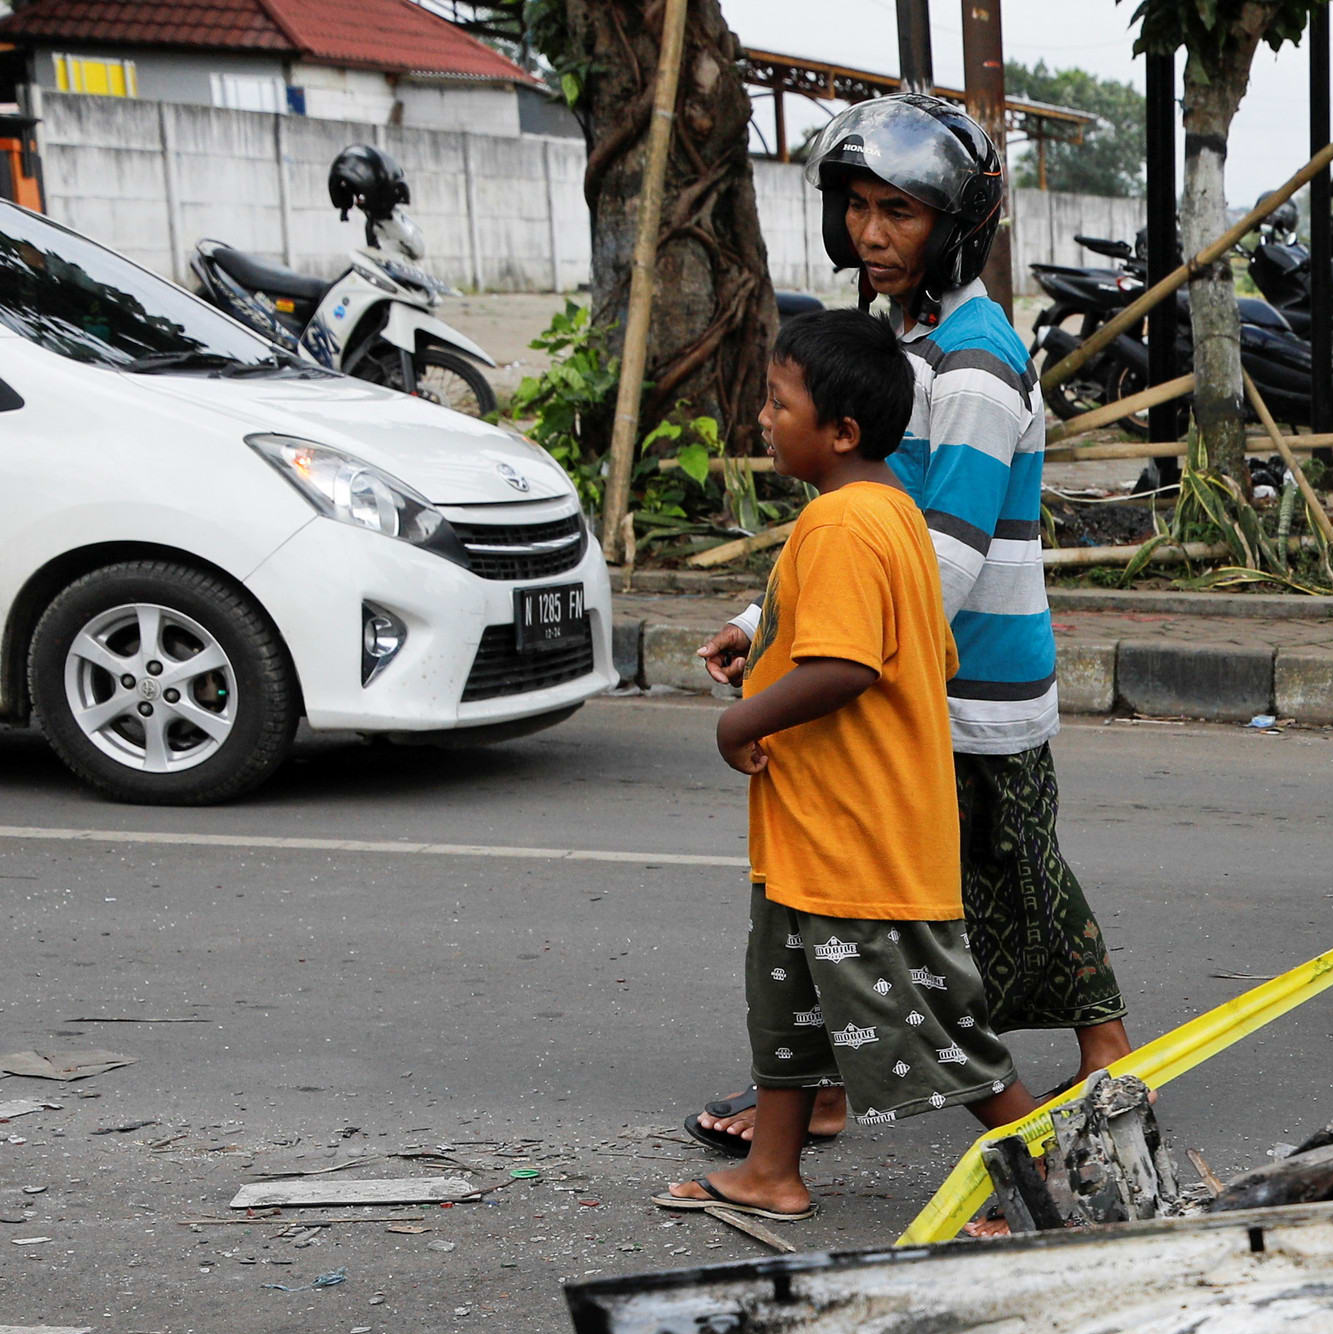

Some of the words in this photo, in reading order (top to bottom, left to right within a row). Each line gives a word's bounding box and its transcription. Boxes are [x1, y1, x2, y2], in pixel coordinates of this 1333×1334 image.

[842, 143, 881, 157] HONDA
[525, 596, 533, 626] N
[539, 593, 561, 623] 1285
[815, 944, 857, 956] MOBILE
[834, 1029, 876, 1042] MOBILE
